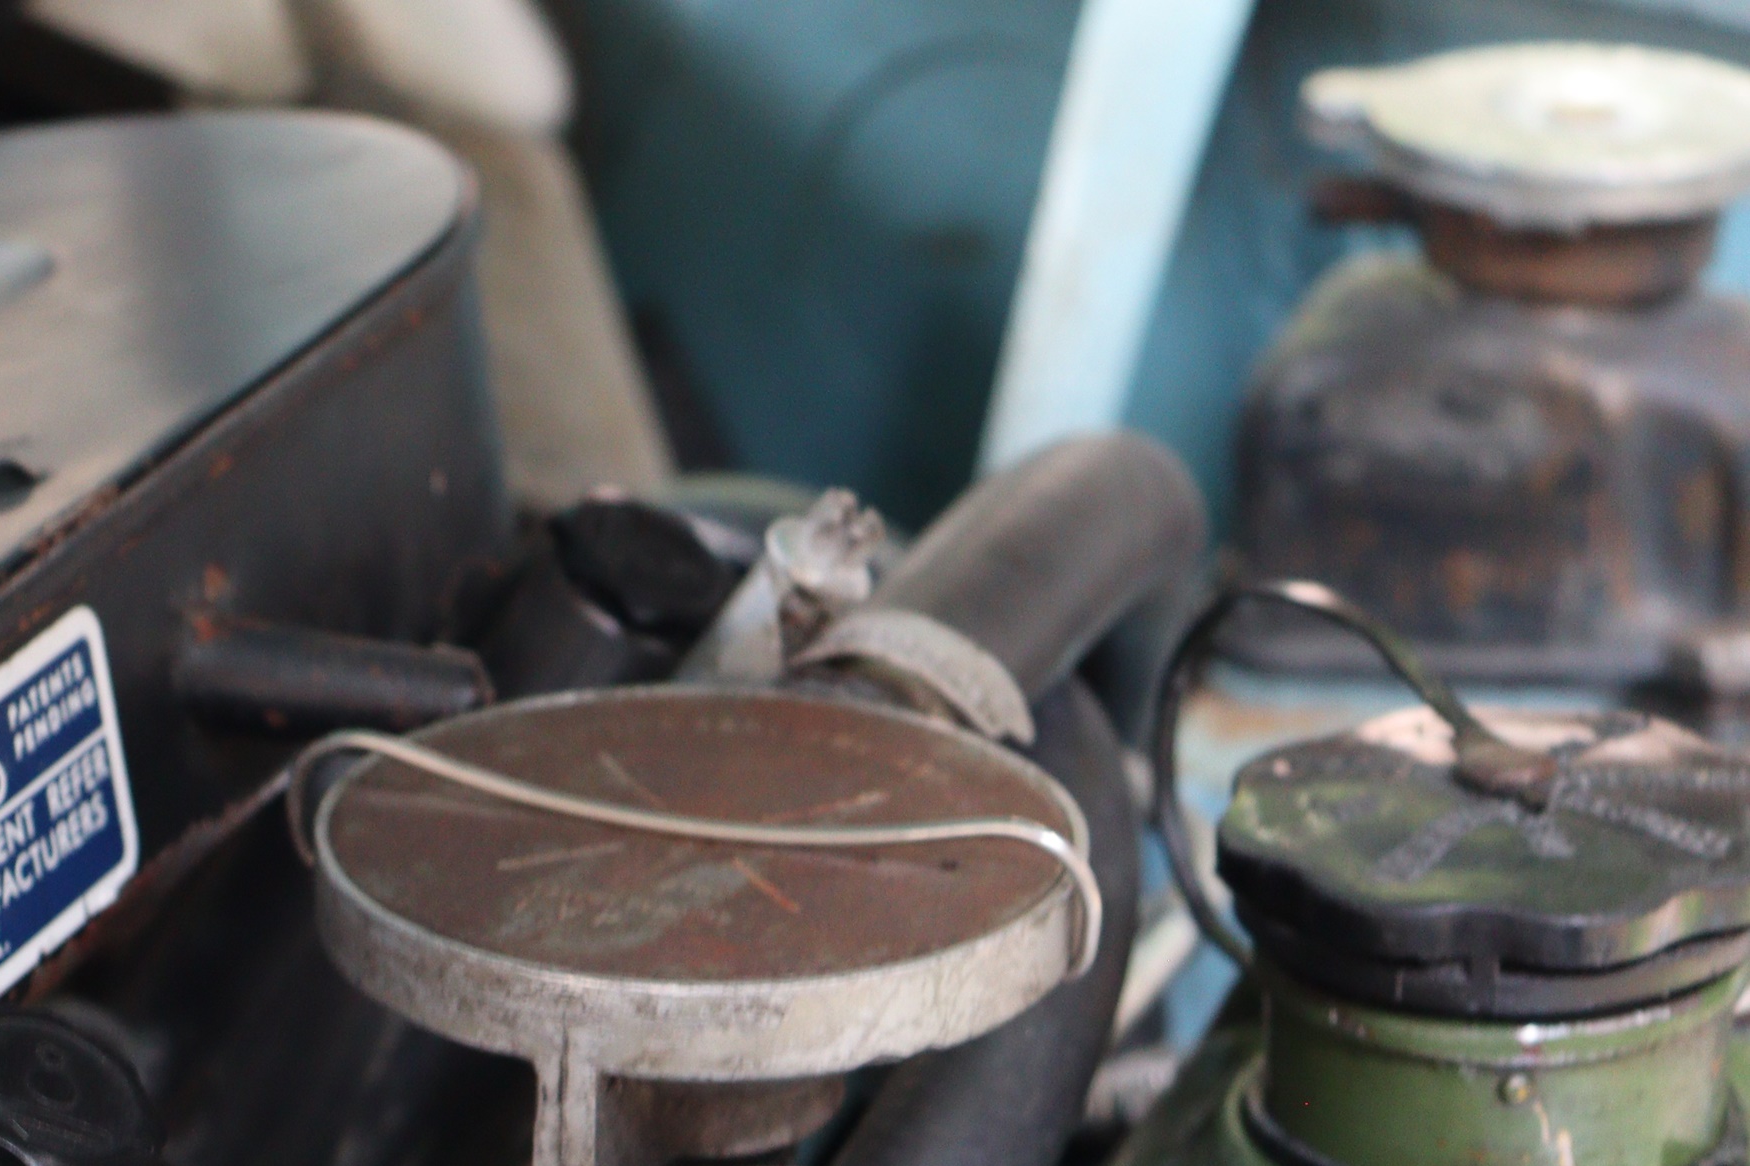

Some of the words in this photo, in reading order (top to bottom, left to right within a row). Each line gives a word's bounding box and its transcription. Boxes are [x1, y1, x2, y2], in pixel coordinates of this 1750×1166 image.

[7, 651, 85, 729] PATENTS
[14, 680, 95, 760] PENDING
[47, 744, 110, 815] REFER
